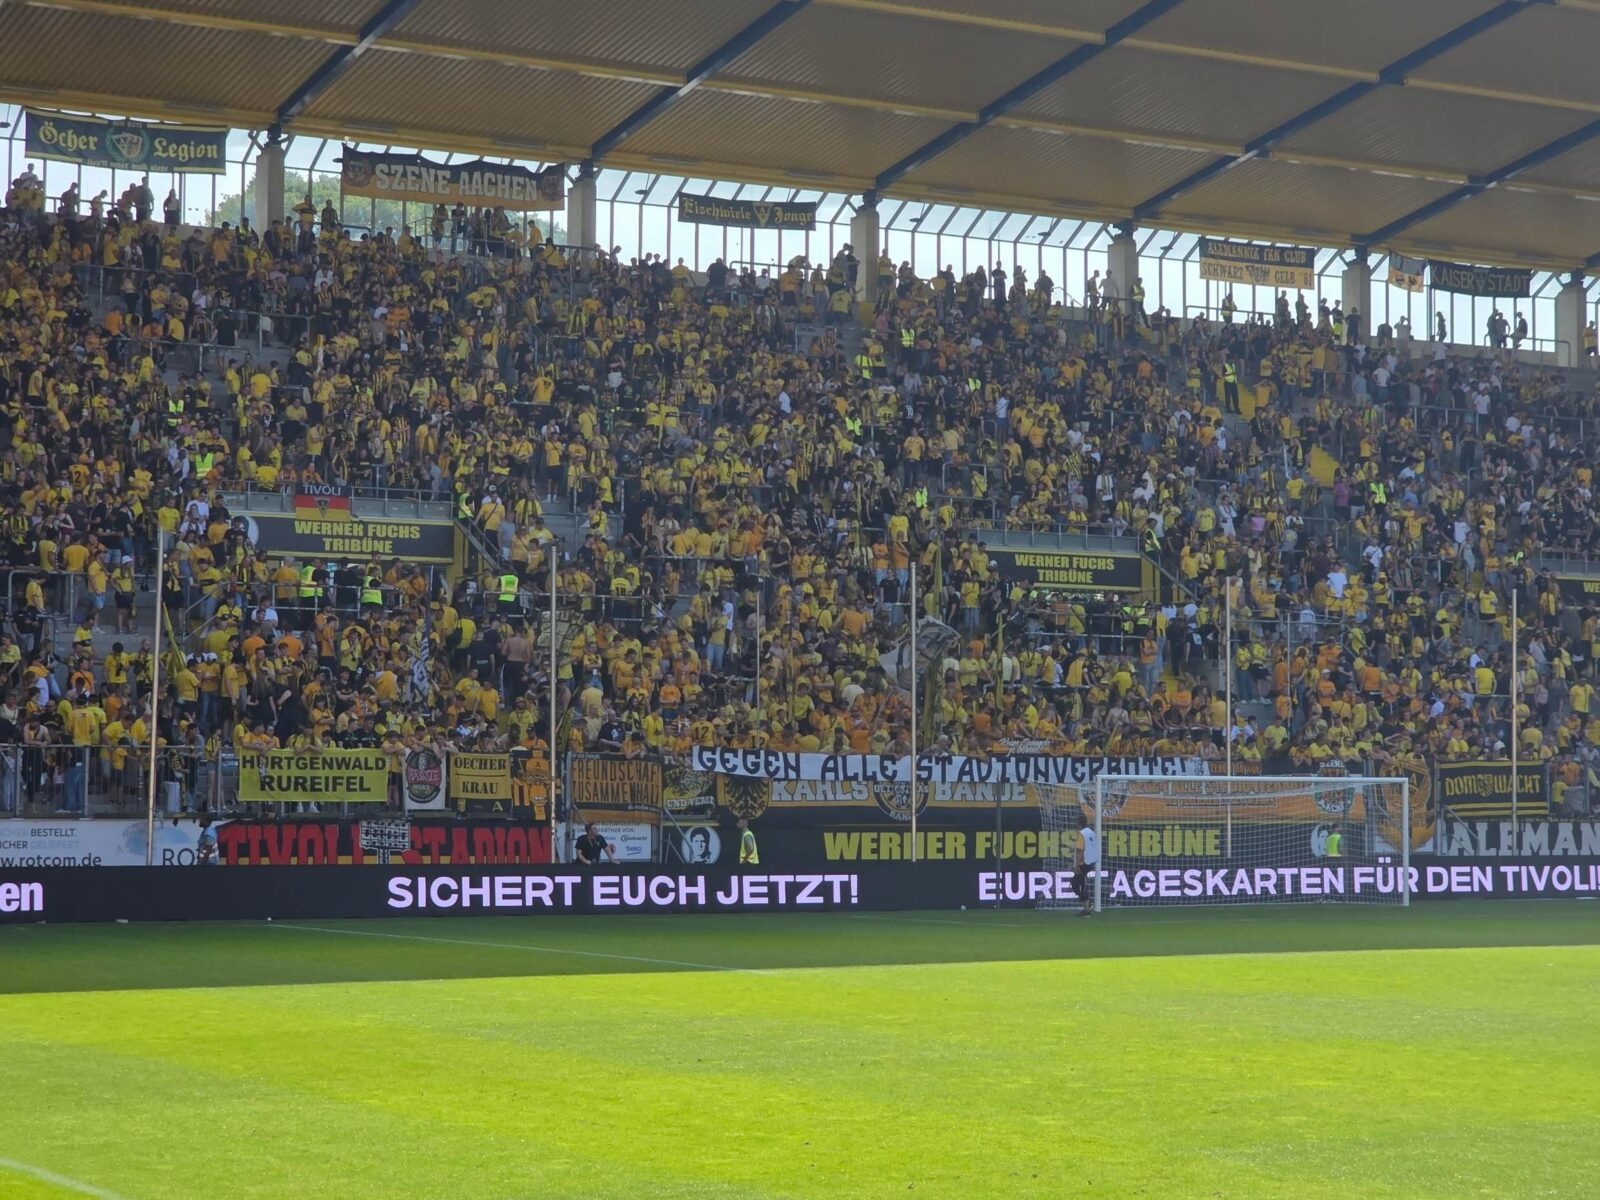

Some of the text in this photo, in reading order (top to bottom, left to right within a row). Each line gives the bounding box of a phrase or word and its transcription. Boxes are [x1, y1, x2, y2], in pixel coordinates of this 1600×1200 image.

[38, 121, 218, 162] Öcher Legion
[375, 163, 538, 201] SZENE AACHEN
[1274, 270, 1296, 285] GELB
[1431, 264, 1530, 293] KAISER STADT
[302, 484, 341, 497] TIVOLI
[294, 520, 422, 540] WERNER FUCHS
[322, 536, 394, 554] TRIBÜNE
[1014, 553, 1115, 570] WERNER FUCHS
[1036, 568, 1094, 584] TRIBÜNE
[454, 756, 507, 771] OECHER
[698, 746, 800, 779] GEGEN
[820, 753, 898, 782] ALLE
[260, 774, 371, 793] RUREIFEL
[462, 780, 499, 795] KRAU
[771, 779, 1027, 802] KARLS BANDE
[1445, 773, 1541, 797] DOM WACHT
[30, 827, 78, 837] BESTELLT.
[823, 825, 1221, 861] WERNER FUCHS RIBÜNE
[978, 870, 1080, 900] EURE
[1353, 856, 1419, 894] FÜR
[1426, 866, 1494, 893] DEN
[1500, 864, 1600, 892] TIVOLI!
[387, 874, 859, 909] SICHERT EUCH JETZT!
